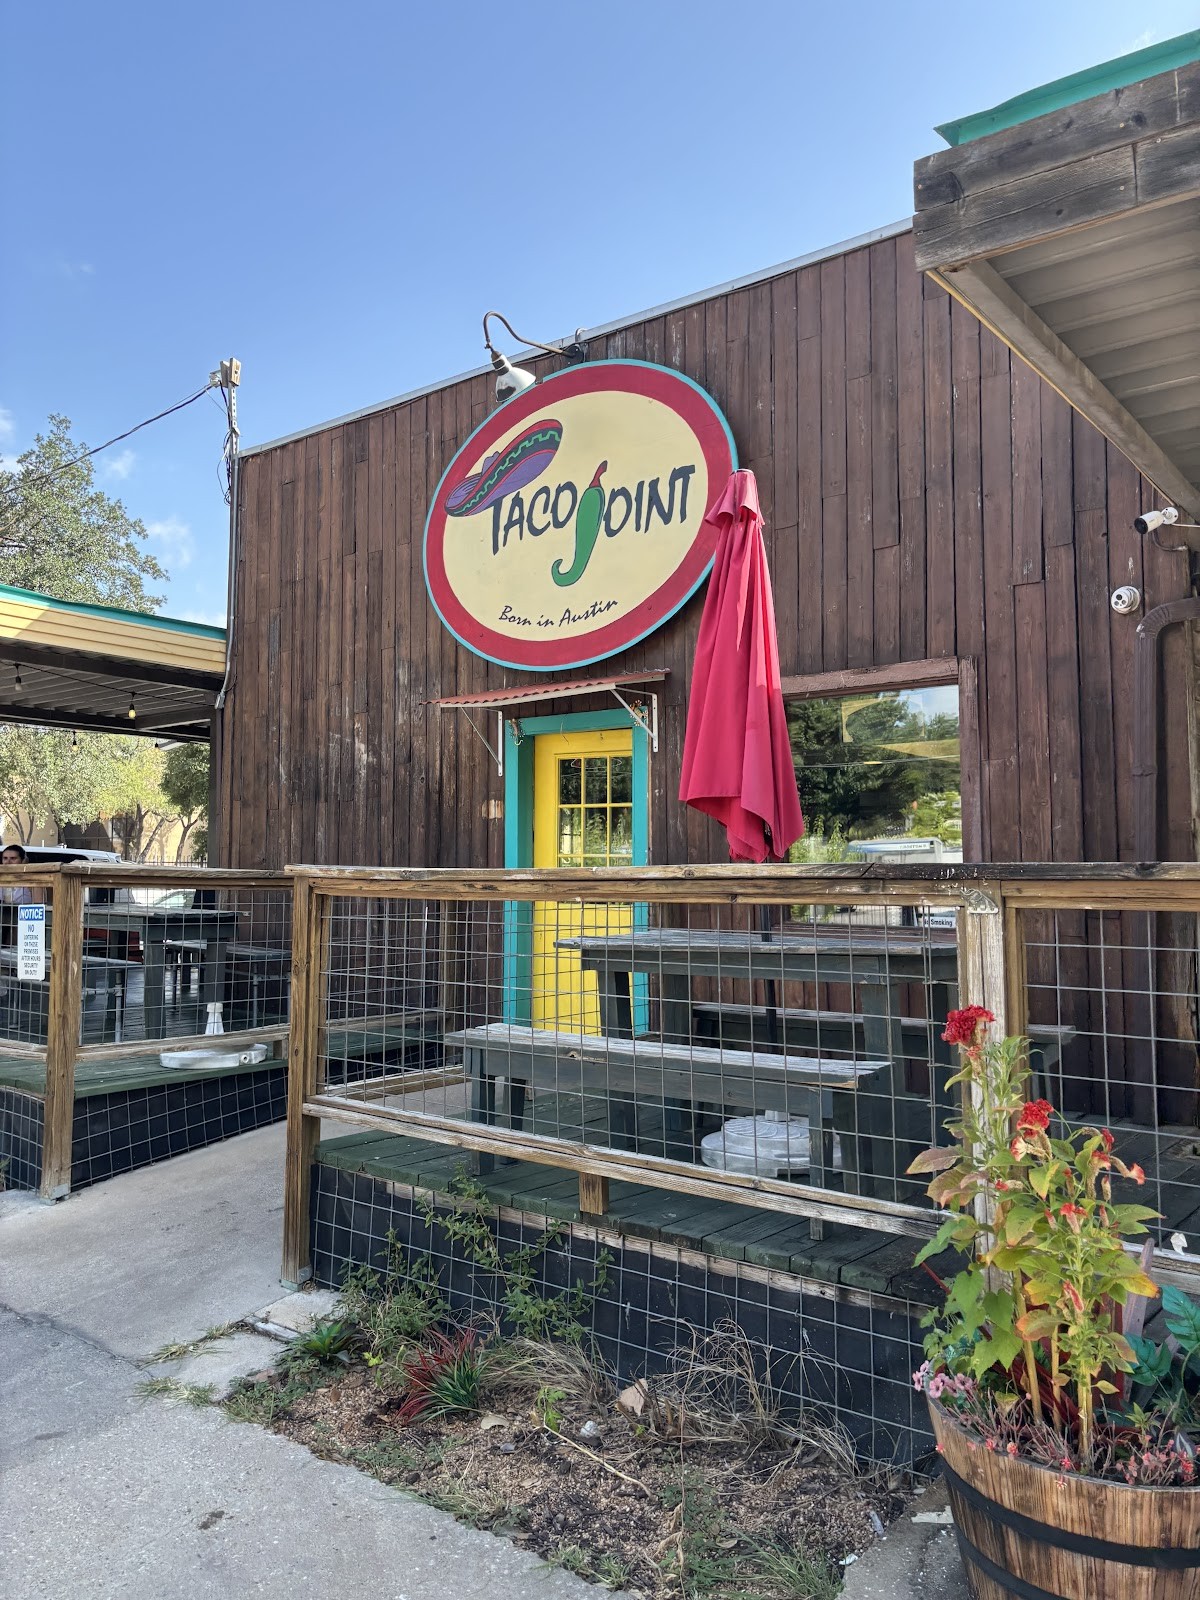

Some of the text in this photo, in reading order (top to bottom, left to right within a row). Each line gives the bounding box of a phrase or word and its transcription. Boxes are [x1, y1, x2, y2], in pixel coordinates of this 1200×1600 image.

[490, 480, 578, 556] TACO
[498, 600, 619, 627] Born in Austin
[20, 909, 43, 919] NOTICE
[27, 924, 35, 932] NO
[930, 918, 953, 928] Smoking
